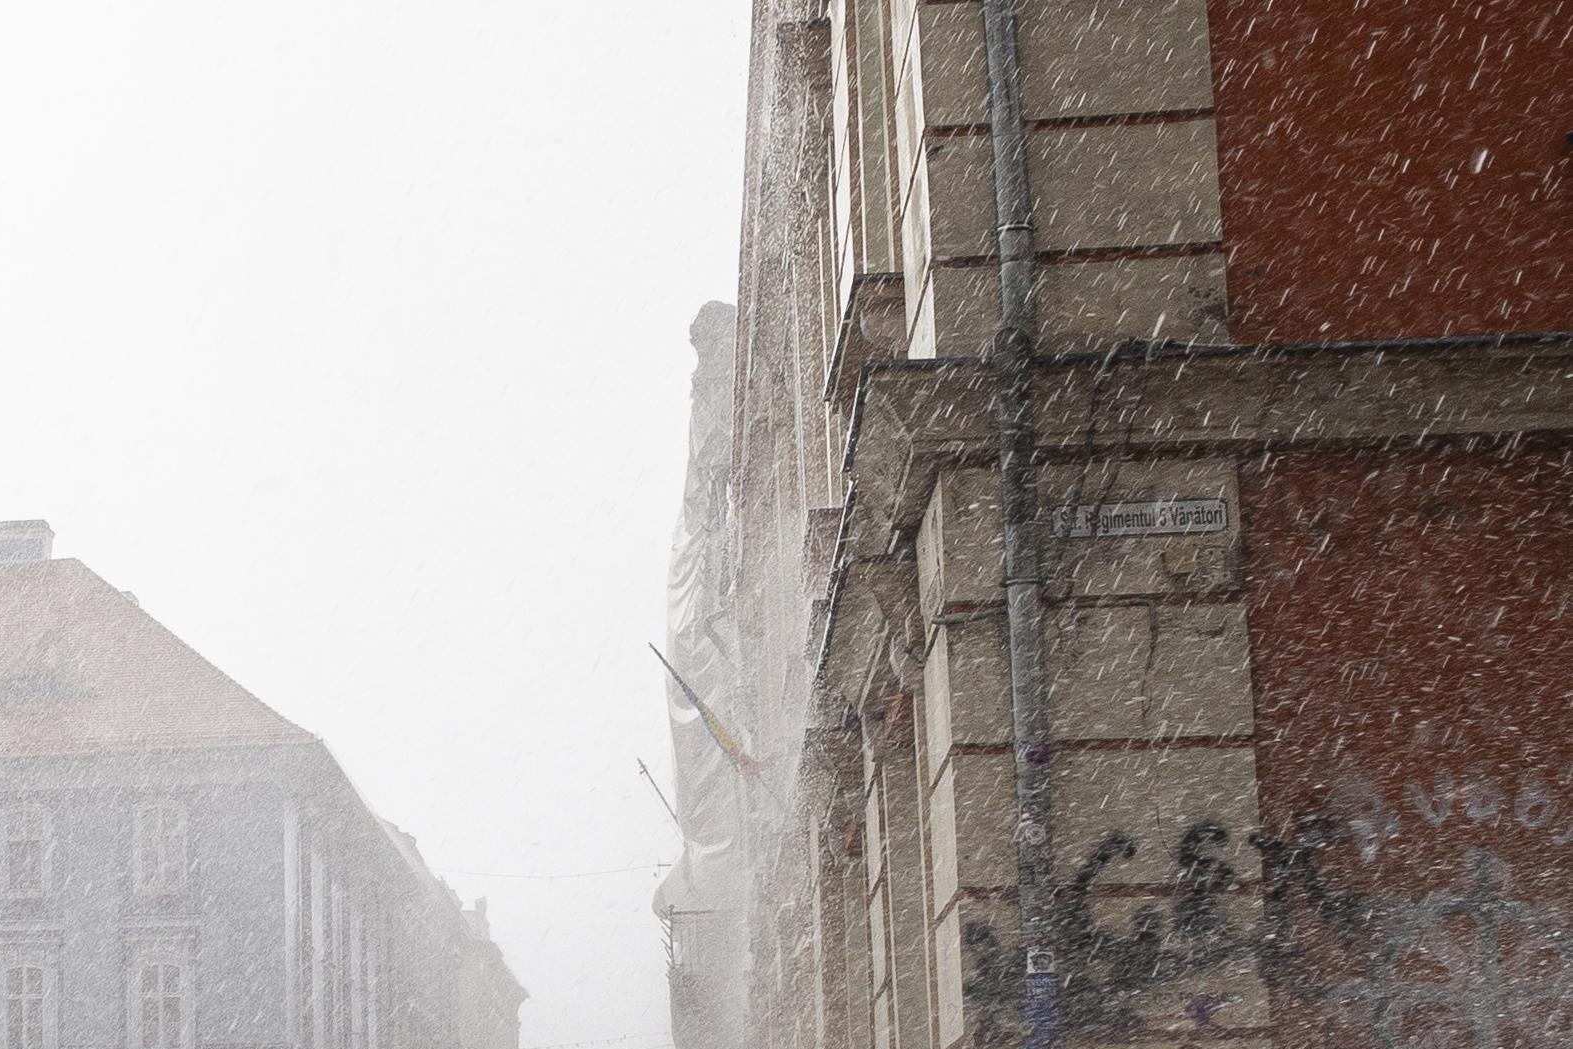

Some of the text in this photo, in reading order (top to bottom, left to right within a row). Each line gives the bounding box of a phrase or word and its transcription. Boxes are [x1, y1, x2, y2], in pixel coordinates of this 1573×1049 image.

[1085, 508, 1156, 533] Regimentul
[1159, 507, 1167, 526] 5
[1169, 503, 1223, 526] Vânători
